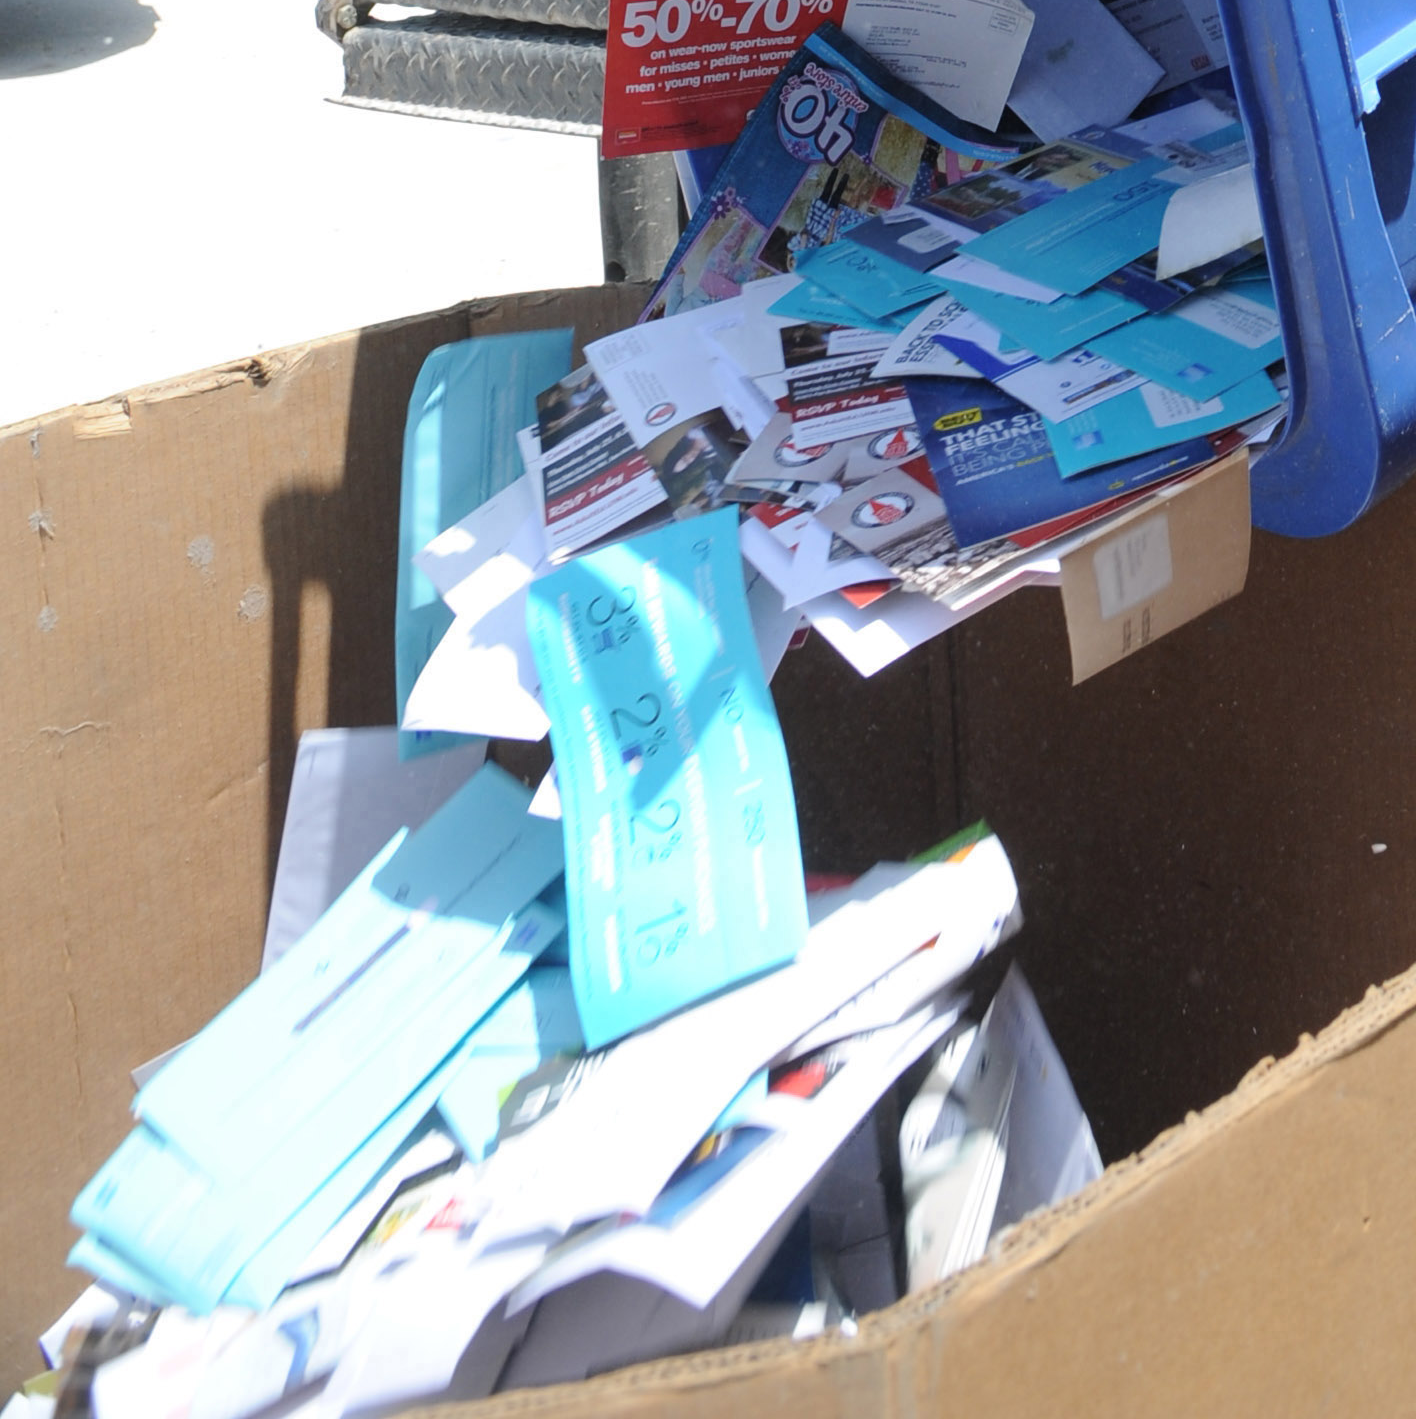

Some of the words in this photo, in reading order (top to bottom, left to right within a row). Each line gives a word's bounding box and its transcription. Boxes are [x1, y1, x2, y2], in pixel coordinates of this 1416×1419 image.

[650, 50, 666, 60] on
[669, 42, 727, 58] wear-now
[730, 35, 797, 51] sportswear
[639, 65, 656, 77] for
[660, 60, 700, 74] misses
[710, 54, 750, 69] petites
[759, 49, 797, 62] wome
[804, 62, 836, 90] store
[625, 83, 655, 94] men
[664, 75, 701, 92] young
[703, 72, 730, 83] men
[739, 65, 779, 81] juniors
[834, 84, 869, 113] entire
[895, 334, 932, 363] BACK
[922, 318, 944, 332] TO
[795, 402, 837, 419] RSVP
[839, 395, 879, 409] Today
[939, 419, 1006, 445] THAT
[944, 421, 1045, 457] FEELING
[952, 447, 1026, 476] BEING
[549, 491, 587, 518] RSVP
[588, 473, 625, 496] Today
[610, 692, 668, 757] 2%
